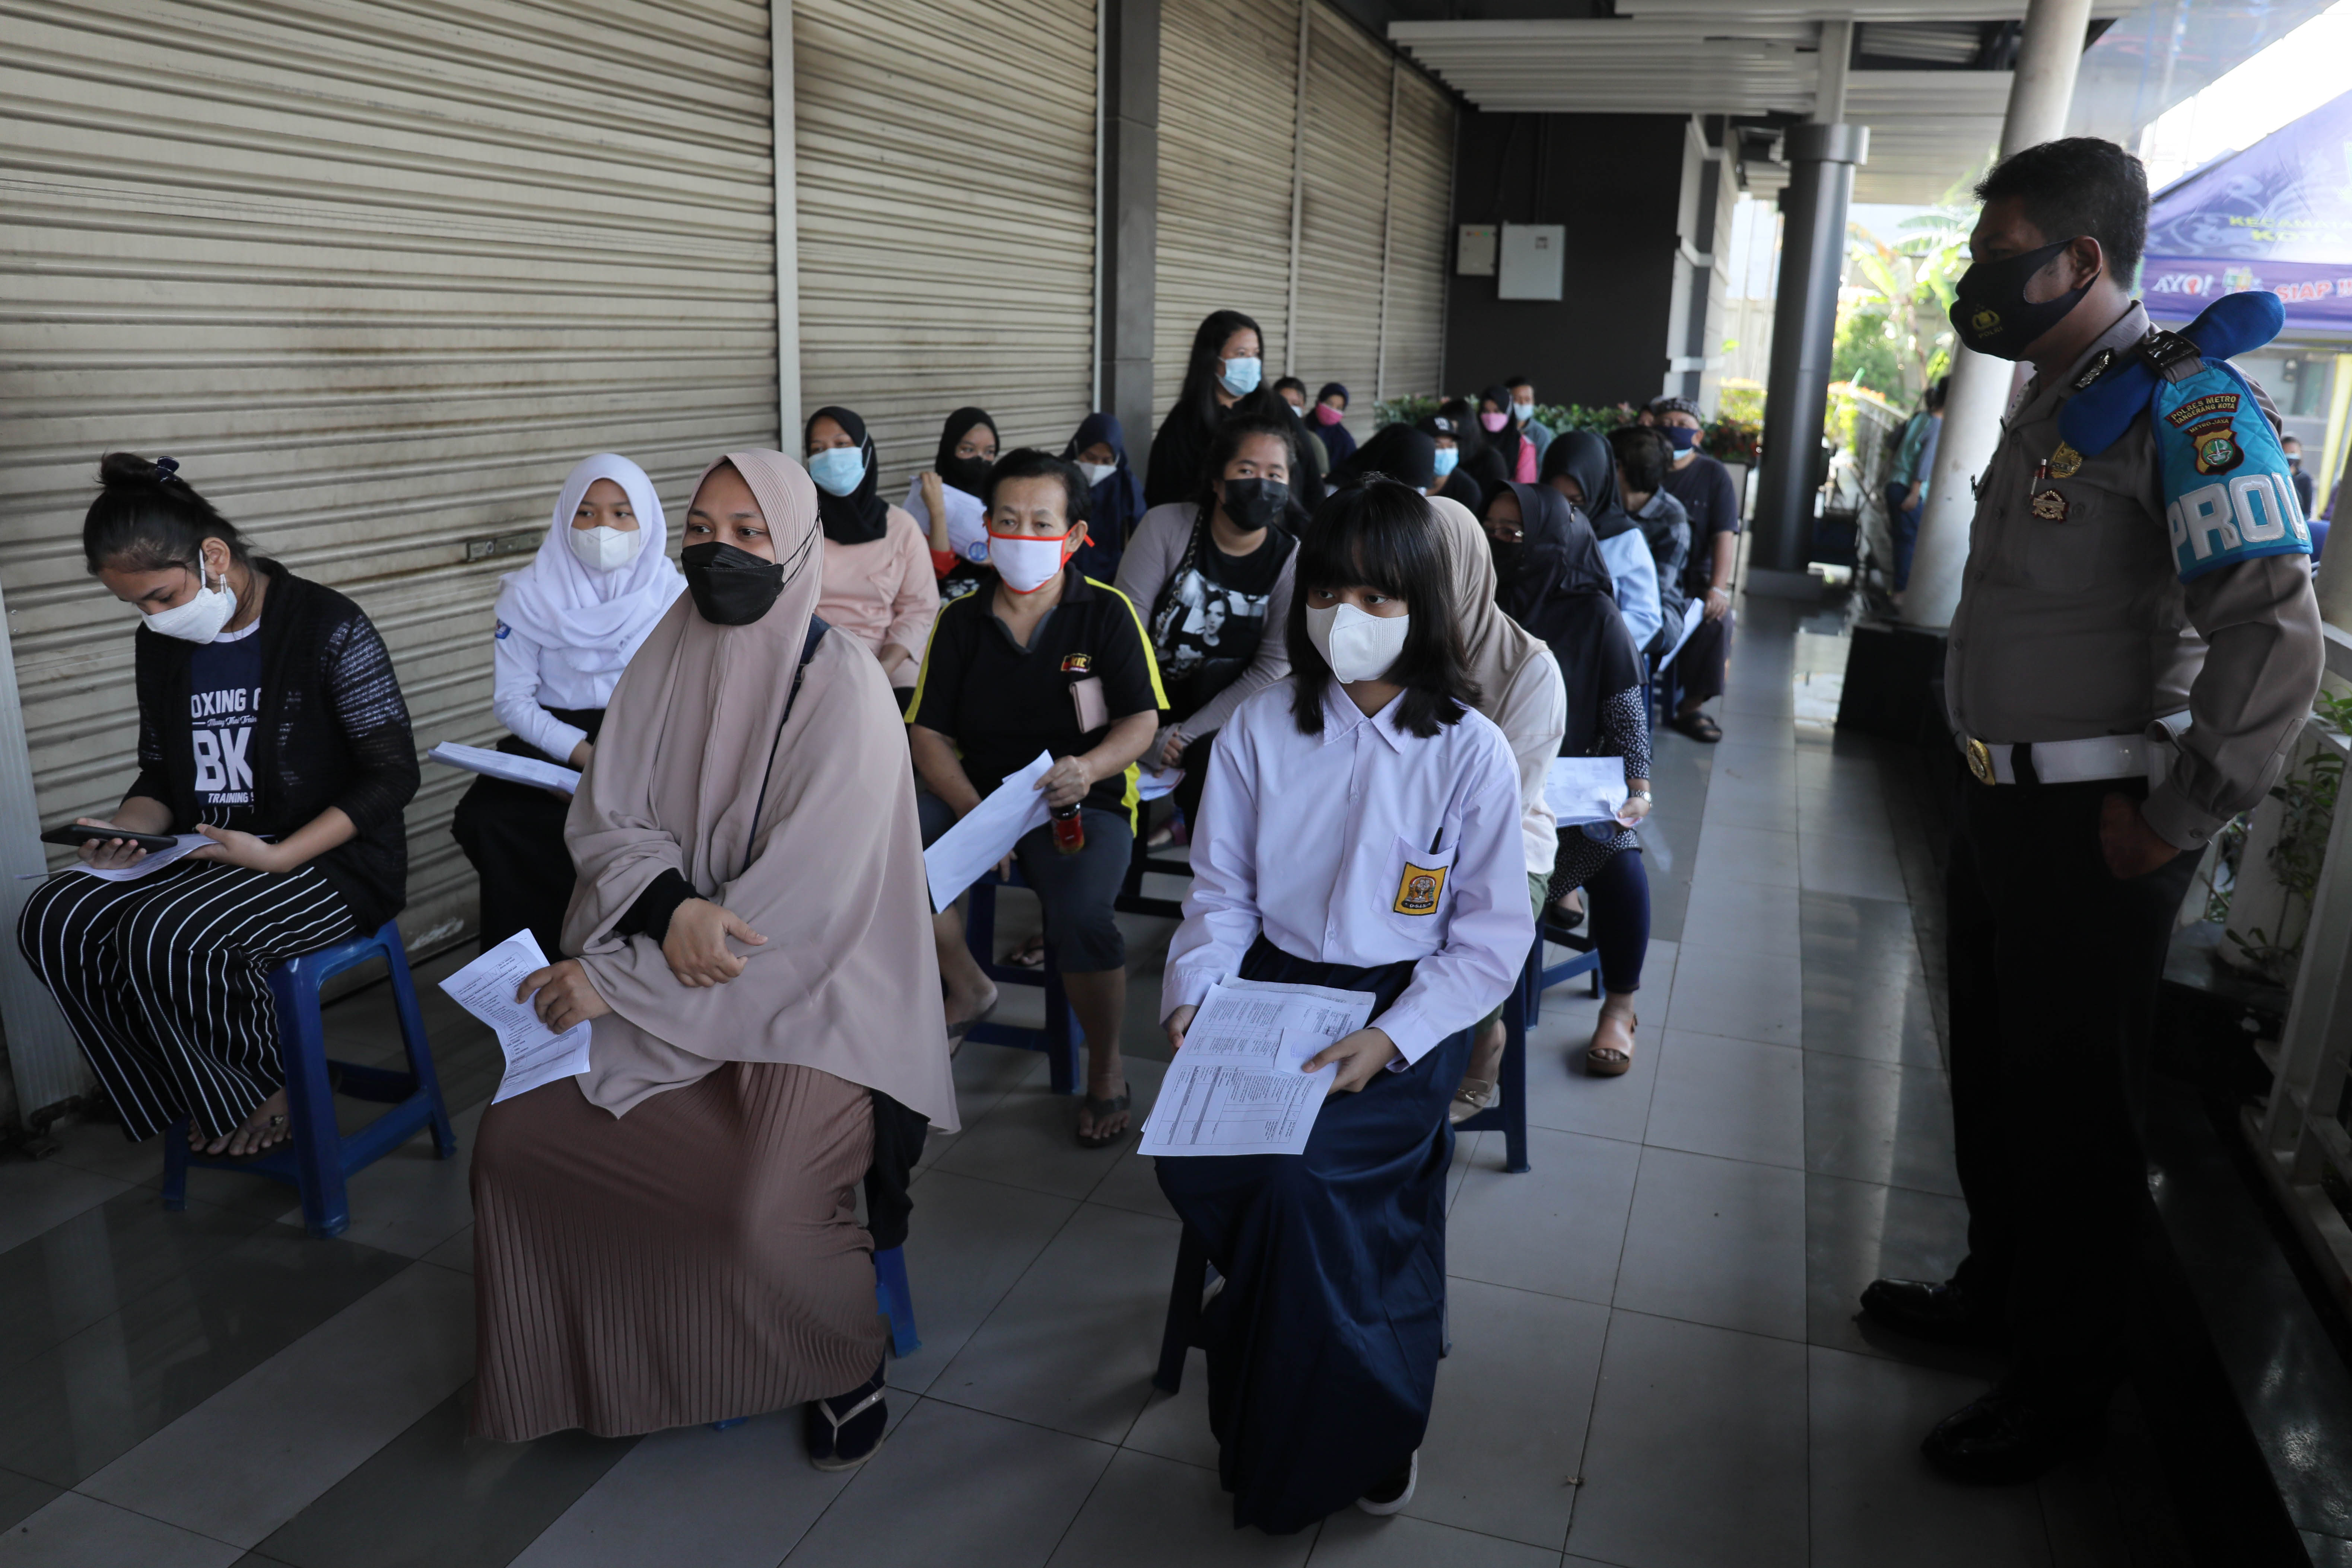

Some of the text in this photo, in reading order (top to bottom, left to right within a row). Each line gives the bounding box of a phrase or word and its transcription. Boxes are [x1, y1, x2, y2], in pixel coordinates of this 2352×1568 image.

[2252, 229, 2343, 242] KOTA
[2152, 274, 2213, 296] AYO!
[2275, 280, 2332, 303] SIAP
[1978, 325, 2003, 340] POLRI
[2171, 396, 2236, 420] POLRES METRO
[2175, 404, 2216, 424] TANGERANG
[207, 718, 225, 727] Muay
[225, 716, 240, 725] Thai
[208, 792, 249, 803] TRAINING
